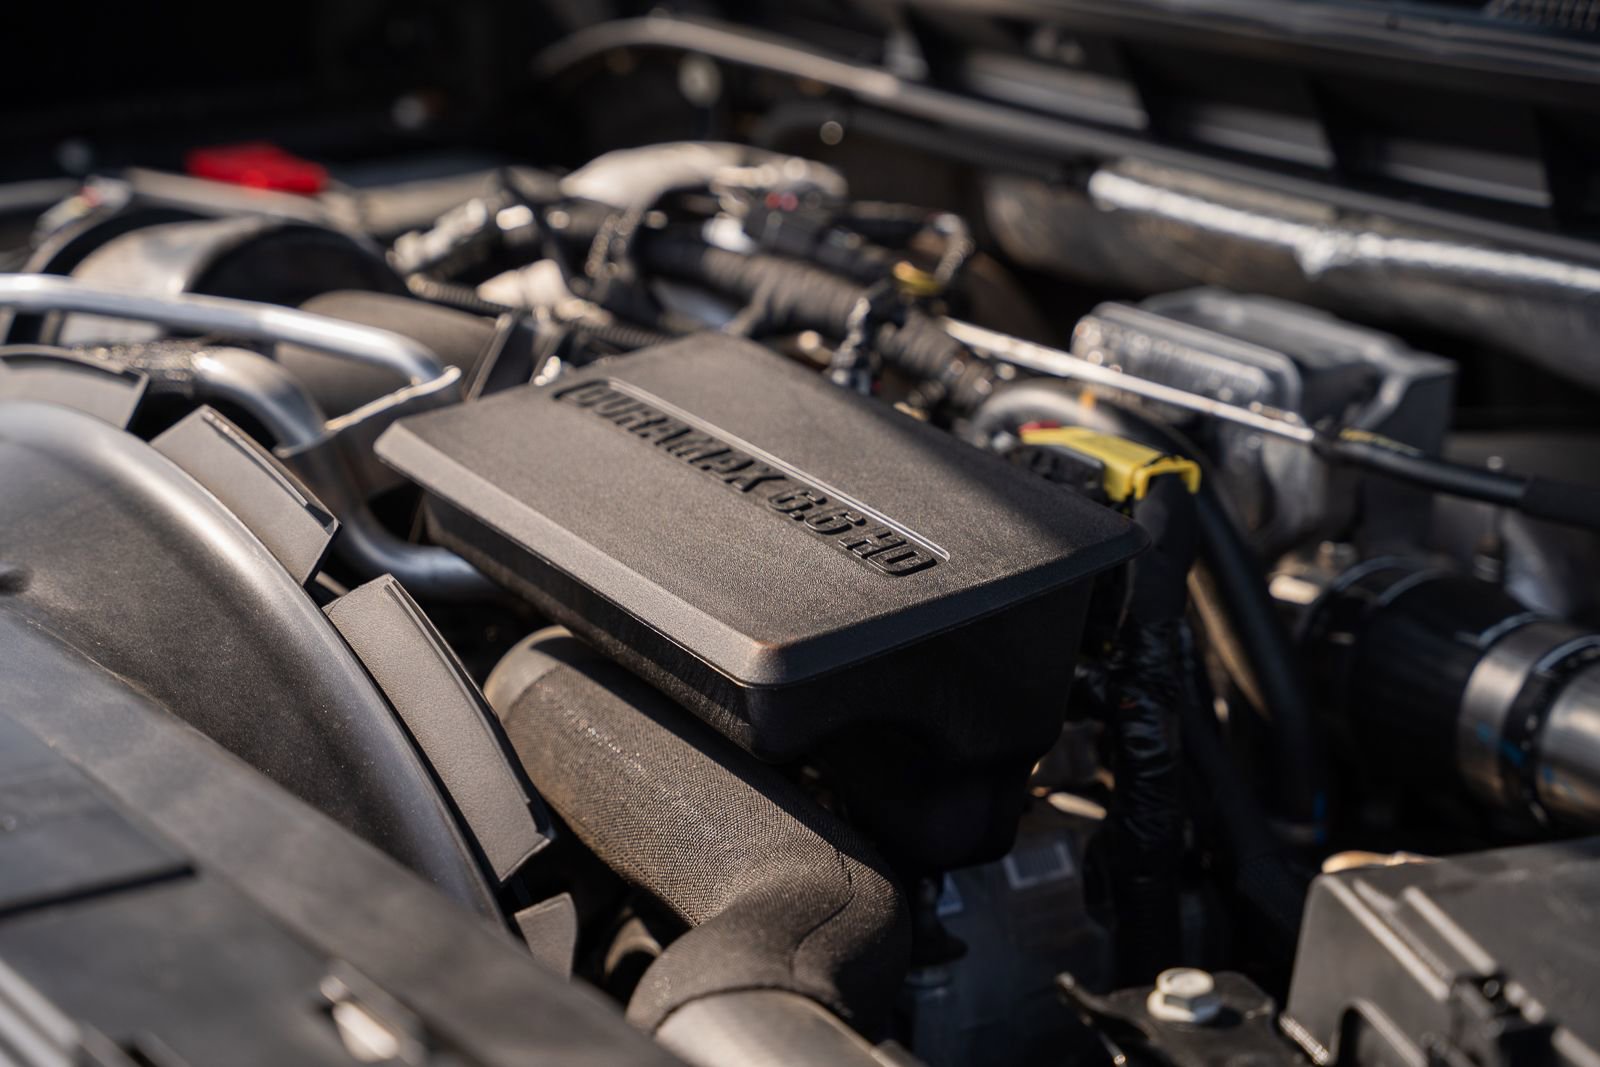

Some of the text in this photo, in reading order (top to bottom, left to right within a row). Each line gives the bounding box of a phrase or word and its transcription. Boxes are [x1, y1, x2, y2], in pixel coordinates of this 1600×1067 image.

[556, 383, 939, 577] DURAMAX 6.6 HD
